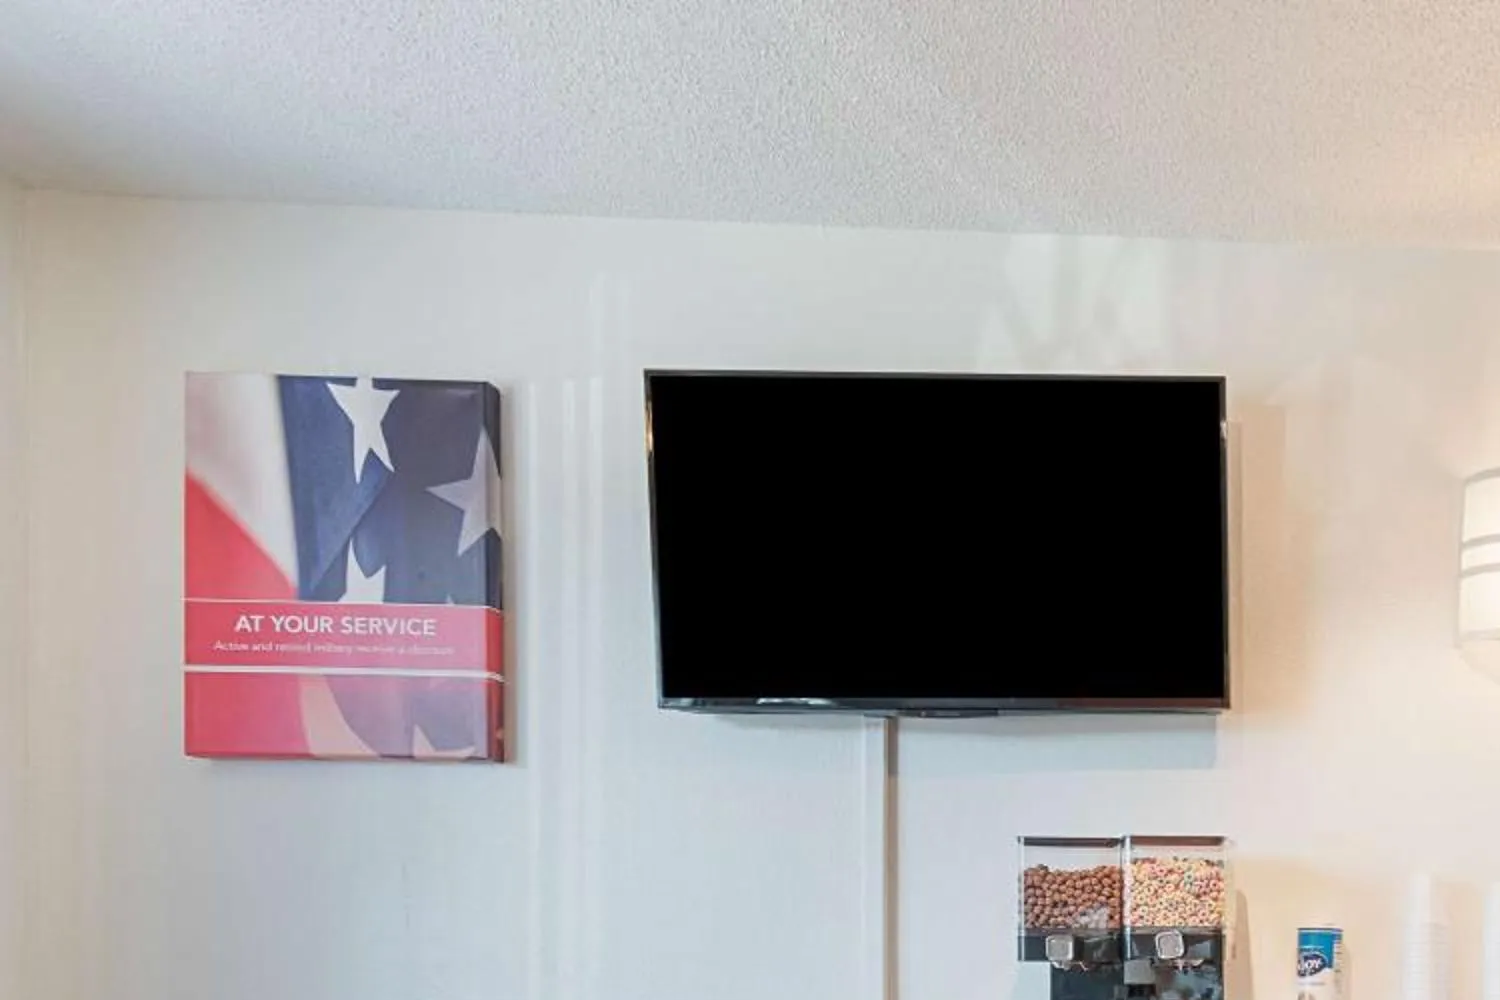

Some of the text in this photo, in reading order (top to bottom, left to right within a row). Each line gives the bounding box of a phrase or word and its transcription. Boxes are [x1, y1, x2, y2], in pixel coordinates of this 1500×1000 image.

[235, 615, 437, 636] AT YOUR SERVICE
[252, 641, 273, 652] and
